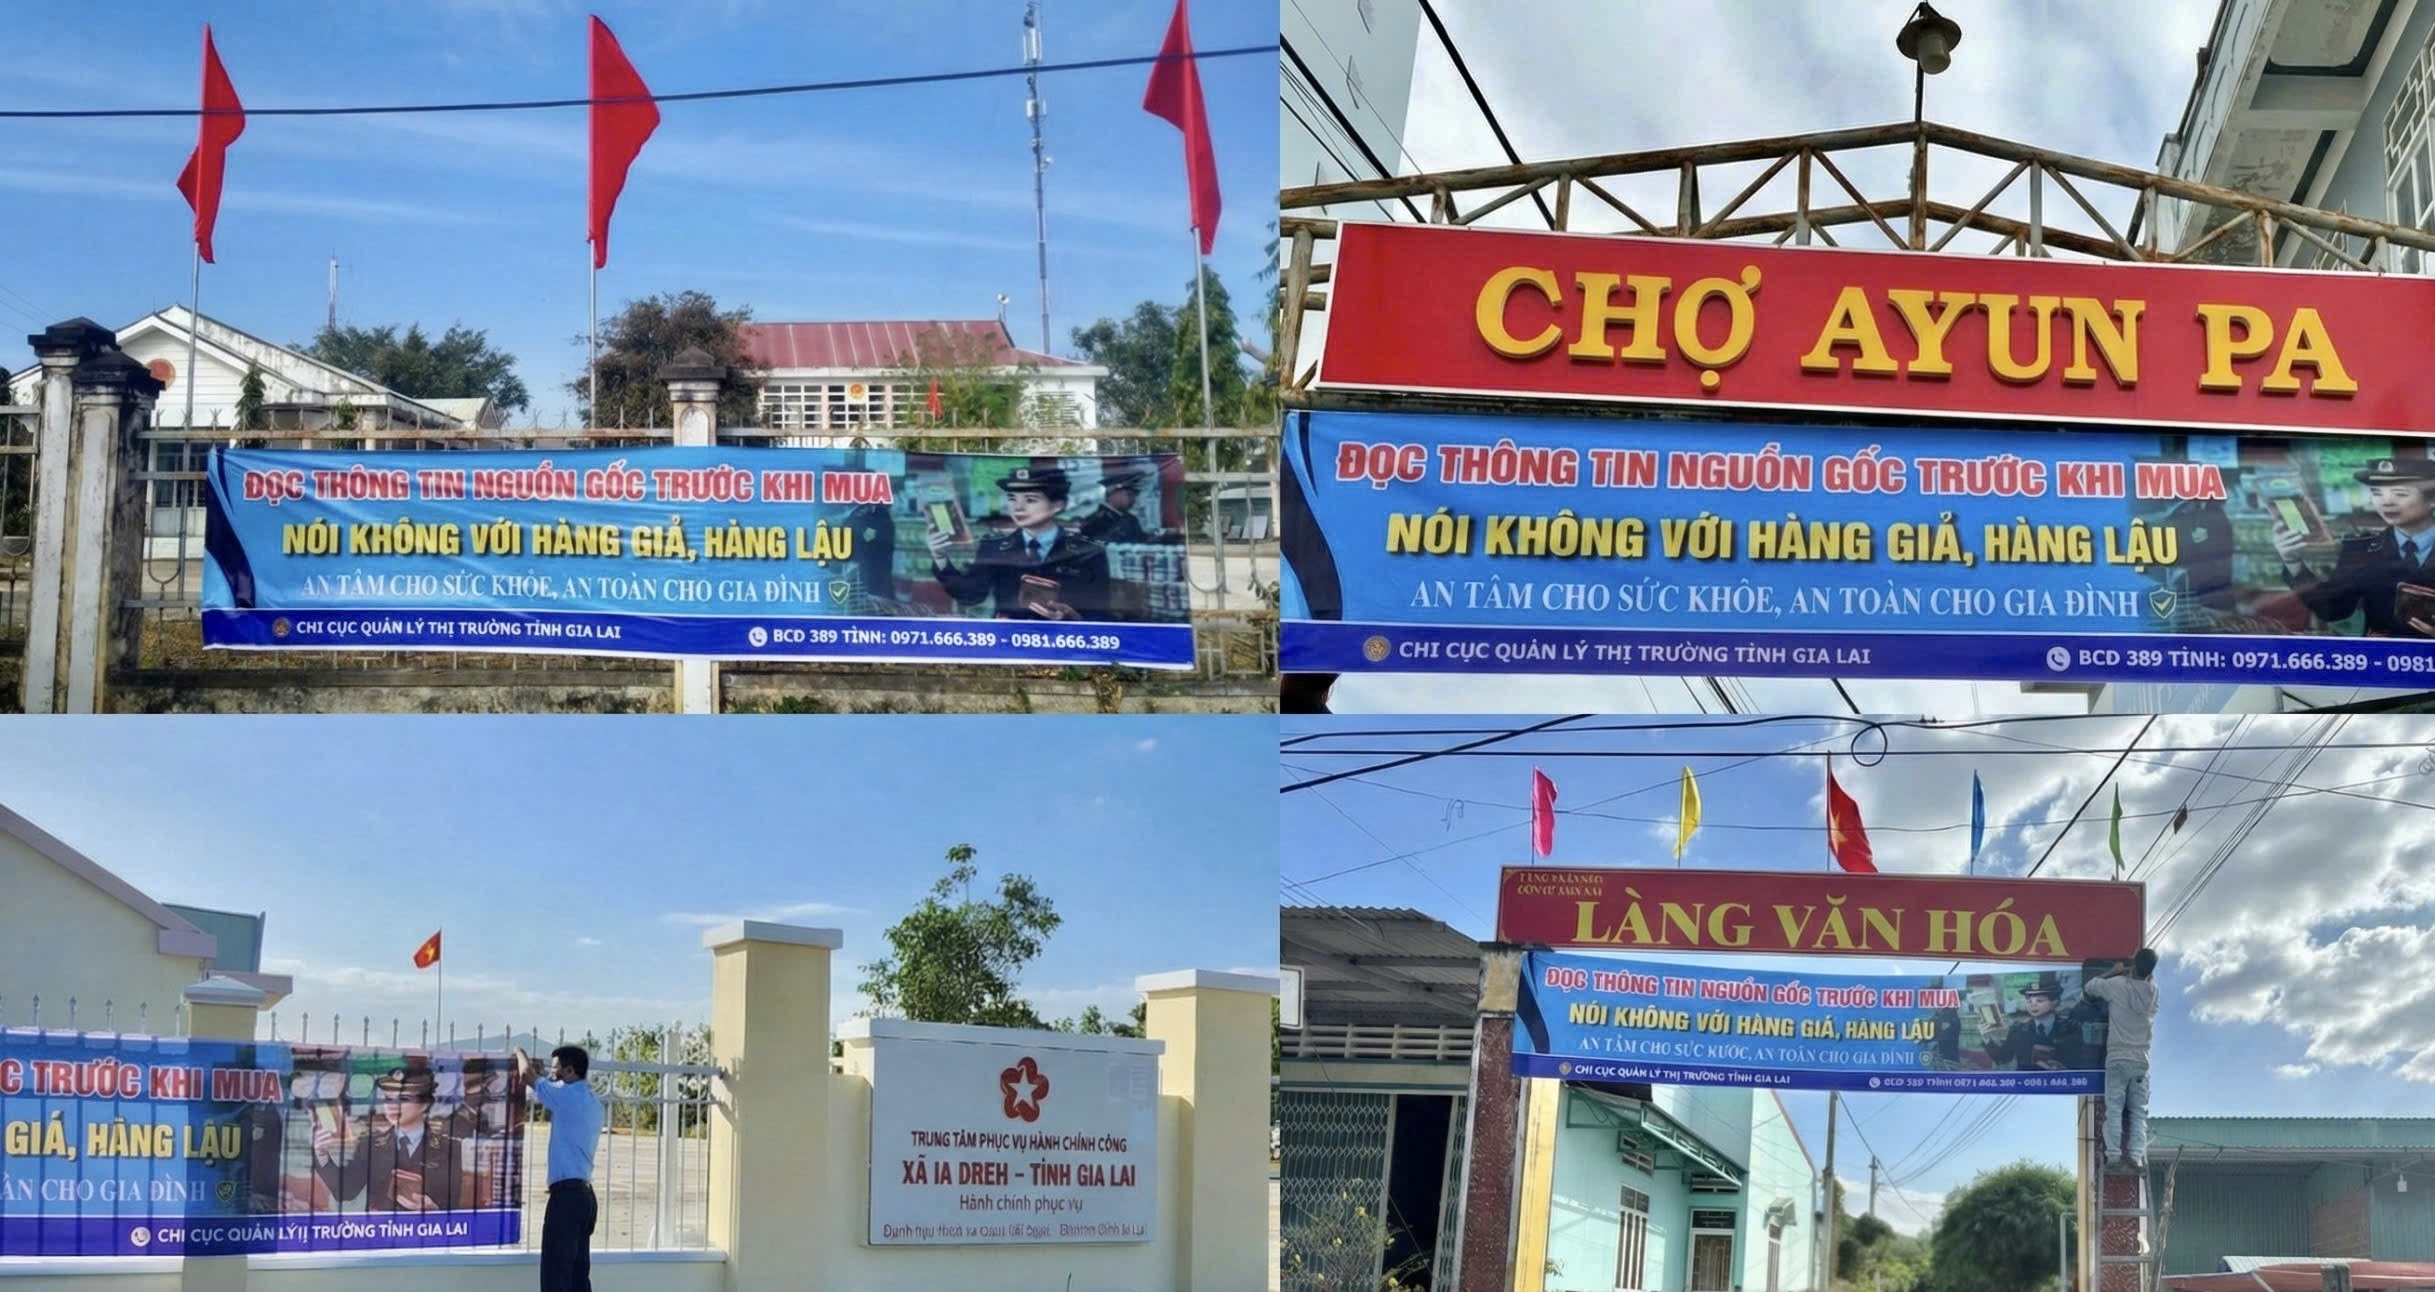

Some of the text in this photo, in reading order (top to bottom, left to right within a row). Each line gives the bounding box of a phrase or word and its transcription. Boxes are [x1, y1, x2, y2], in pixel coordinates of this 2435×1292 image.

[1476, 264, 2359, 397] CHỢ AYUN PA
[244, 470, 305, 505] ĐỌC
[312, 464, 410, 500] THÔNG
[418, 469, 465, 500] TIN
[584, 459, 646, 501] GỐC
[653, 464, 755, 504] TRƯỚC
[761, 470, 815, 503] KHI
[822, 472, 893, 504] MUA
[1336, 441, 1427, 490] ĐỌC
[1437, 438, 1579, 486] THÔNG
[1589, 448, 1658, 488] TIN
[1823, 444, 1907, 494] GỐC
[1914, 454, 2047, 497] TRƯỚC
[2056, 461, 2125, 498] KHI
[2135, 462, 2227, 500] MUA
[283, 517, 339, 554] NÓI
[470, 516, 521, 554] VỚI
[531, 517, 621, 556] HÀNG
[631, 515, 698, 562] GIẢ,
[796, 520, 852, 567] LẬU
[1386, 506, 2178, 573] NÓI KHÔNG VỚI HÀNG GIẢ, HÀNG LẬU
[302, 574, 331, 596] AN
[336, 568, 385, 596] TÂM
[390, 574, 437, 597] CHO
[443, 569, 486, 597] SỨC
[563, 576, 592, 600] AN
[598, 572, 657, 601] TOÀN
[663, 579, 712, 602] CHO
[718, 580, 759, 603] GIA
[764, 574, 821, 604] ĐÌNH
[1410, 580, 1455, 608] AN
[1464, 574, 1533, 609] TÂM
[1542, 583, 1610, 612] CHO
[1618, 577, 1679, 613] SỨC
[1789, 586, 1831, 615] AN
[1839, 579, 1922, 616] TOÀN
[1930, 587, 1996, 616] CHO
[2004, 588, 2058, 618] GIA
[2065, 582, 2140, 618] ĐÌNH
[296, 621, 323, 634] CHI
[327, 621, 357, 637] CỤC
[361, 617, 402, 636] QUẢN
[406, 617, 425, 634] LÝ
[428, 621, 454, 637] THỊ
[458, 619, 521, 636] TRƯỜNG
[566, 625, 592, 638] GIA
[597, 626, 621, 639] LAI
[810, 630, 838, 644] 389
[891, 631, 996, 647] 0971.666.389
[1011, 634, 1120, 649] 0981.666.389
[1399, 642, 1439, 658] CHI
[1446, 642, 1490, 662] CỤC
[1495, 639, 1556, 663] QUẢN
[1563, 640, 1589, 661] LÝ
[1595, 645, 1632, 664] THỊ
[1638, 641, 1729, 663] TRƯỜNG
[1792, 648, 1831, 665] GIA
[1836, 648, 1871, 665] LAI
[2126, 651, 2163, 667] 389
[2232, 652, 2369, 671] 0971.666.389
[1571, 887, 2070, 956] LÀNG VĂN HÓA
[1546, 967, 1588, 992] ĐỌC
[1593, 969, 1659, 995] THÔNG
[1663, 976, 1696, 998] TIN
[1881, 988, 1914, 1008] KHI
[1918, 988, 1961, 1008] MUA
[1569, 1001, 1608, 1025] NÓI
[1614, 1005, 1690, 1031] KHÔNG
[30, 1056, 142, 1099] TRƯỚC
[149, 1065, 204, 1101] KHI
[212, 1068, 283, 1103] MUA
[1575, 1065, 1593, 1075] CHI
[911, 1130, 951, 1148] TRUNG
[979, 1132, 1010, 1152] PHỤC
[1011, 1134, 1027, 1154] VỤ
[1029, 1130, 1061, 1150] HÀNH
[1062, 1131, 1096, 1152] CHÍNH
[902, 1154, 928, 1185] XÃ
[934, 1161, 952, 1185] IA
[959, 1161, 1008, 1185] DREH
[1077, 1163, 1105, 1187] GIA
[1110, 1164, 1136, 1187] LAI
[41, 1178, 94, 1201] CHO
[100, 1179, 143, 1202] GIA
[996, 1193, 1031, 1212] chính
[1034, 1194, 1065, 1215] phục
[1067, 1199, 1083, 1214] vụ
[158, 1228, 185, 1243] CHI
[190, 1228, 224, 1246] CỤC
[227, 1222, 275, 1242] QUẢN
[312, 1221, 375, 1239] TRƯỜNG
[417, 1223, 442, 1237] GIA
[446, 1222, 467, 1235] LAI
